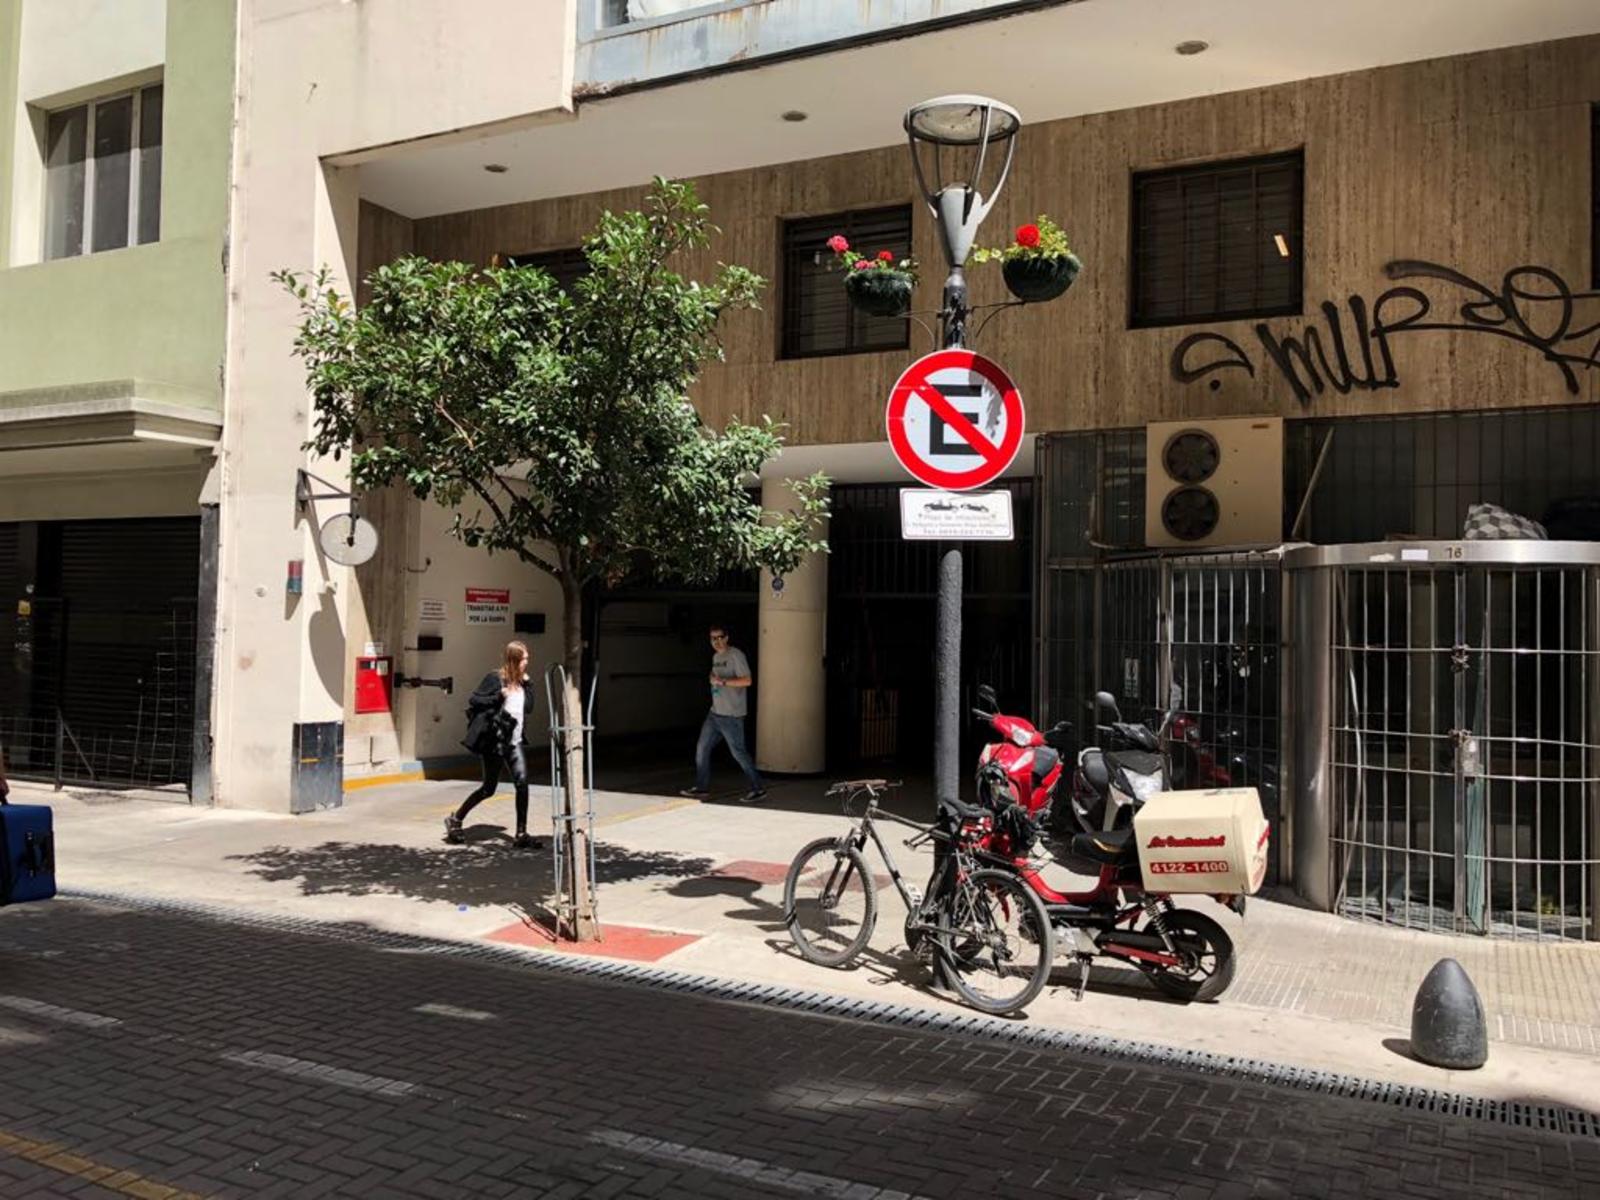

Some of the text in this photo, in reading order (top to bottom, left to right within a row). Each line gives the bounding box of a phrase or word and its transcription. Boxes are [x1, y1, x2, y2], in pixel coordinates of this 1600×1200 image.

[930, 384, 983, 455] E
[1445, 547, 1462, 559] 16
[1152, 862, 1228, 873] 4122-1400
